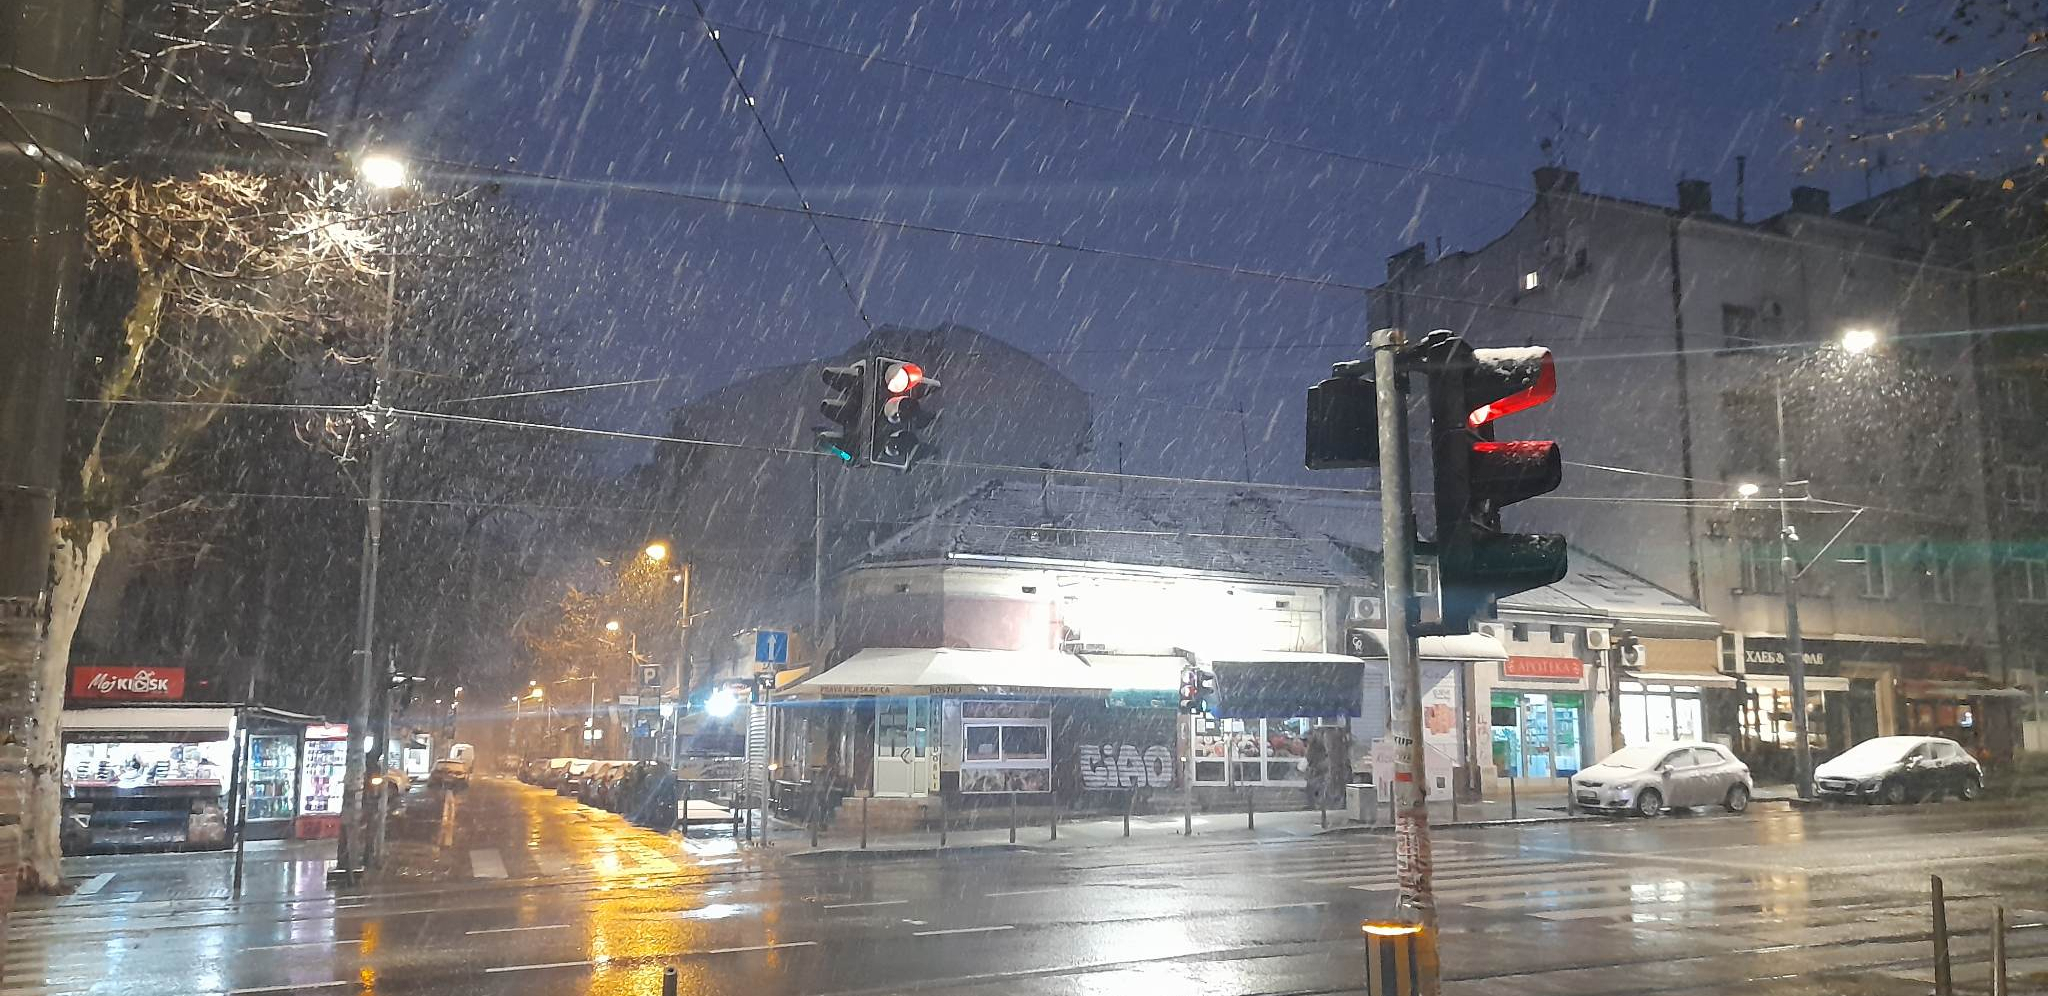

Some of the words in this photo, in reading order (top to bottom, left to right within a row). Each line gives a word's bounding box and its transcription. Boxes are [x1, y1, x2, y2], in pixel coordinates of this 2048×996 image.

[1776, 651, 1785, 664] &
[1519, 660, 1571, 674] APOTEKA
[87, 673, 117, 693] Moj
[117, 670, 169, 692] KIOSK
[643, 667, 656, 684] P
